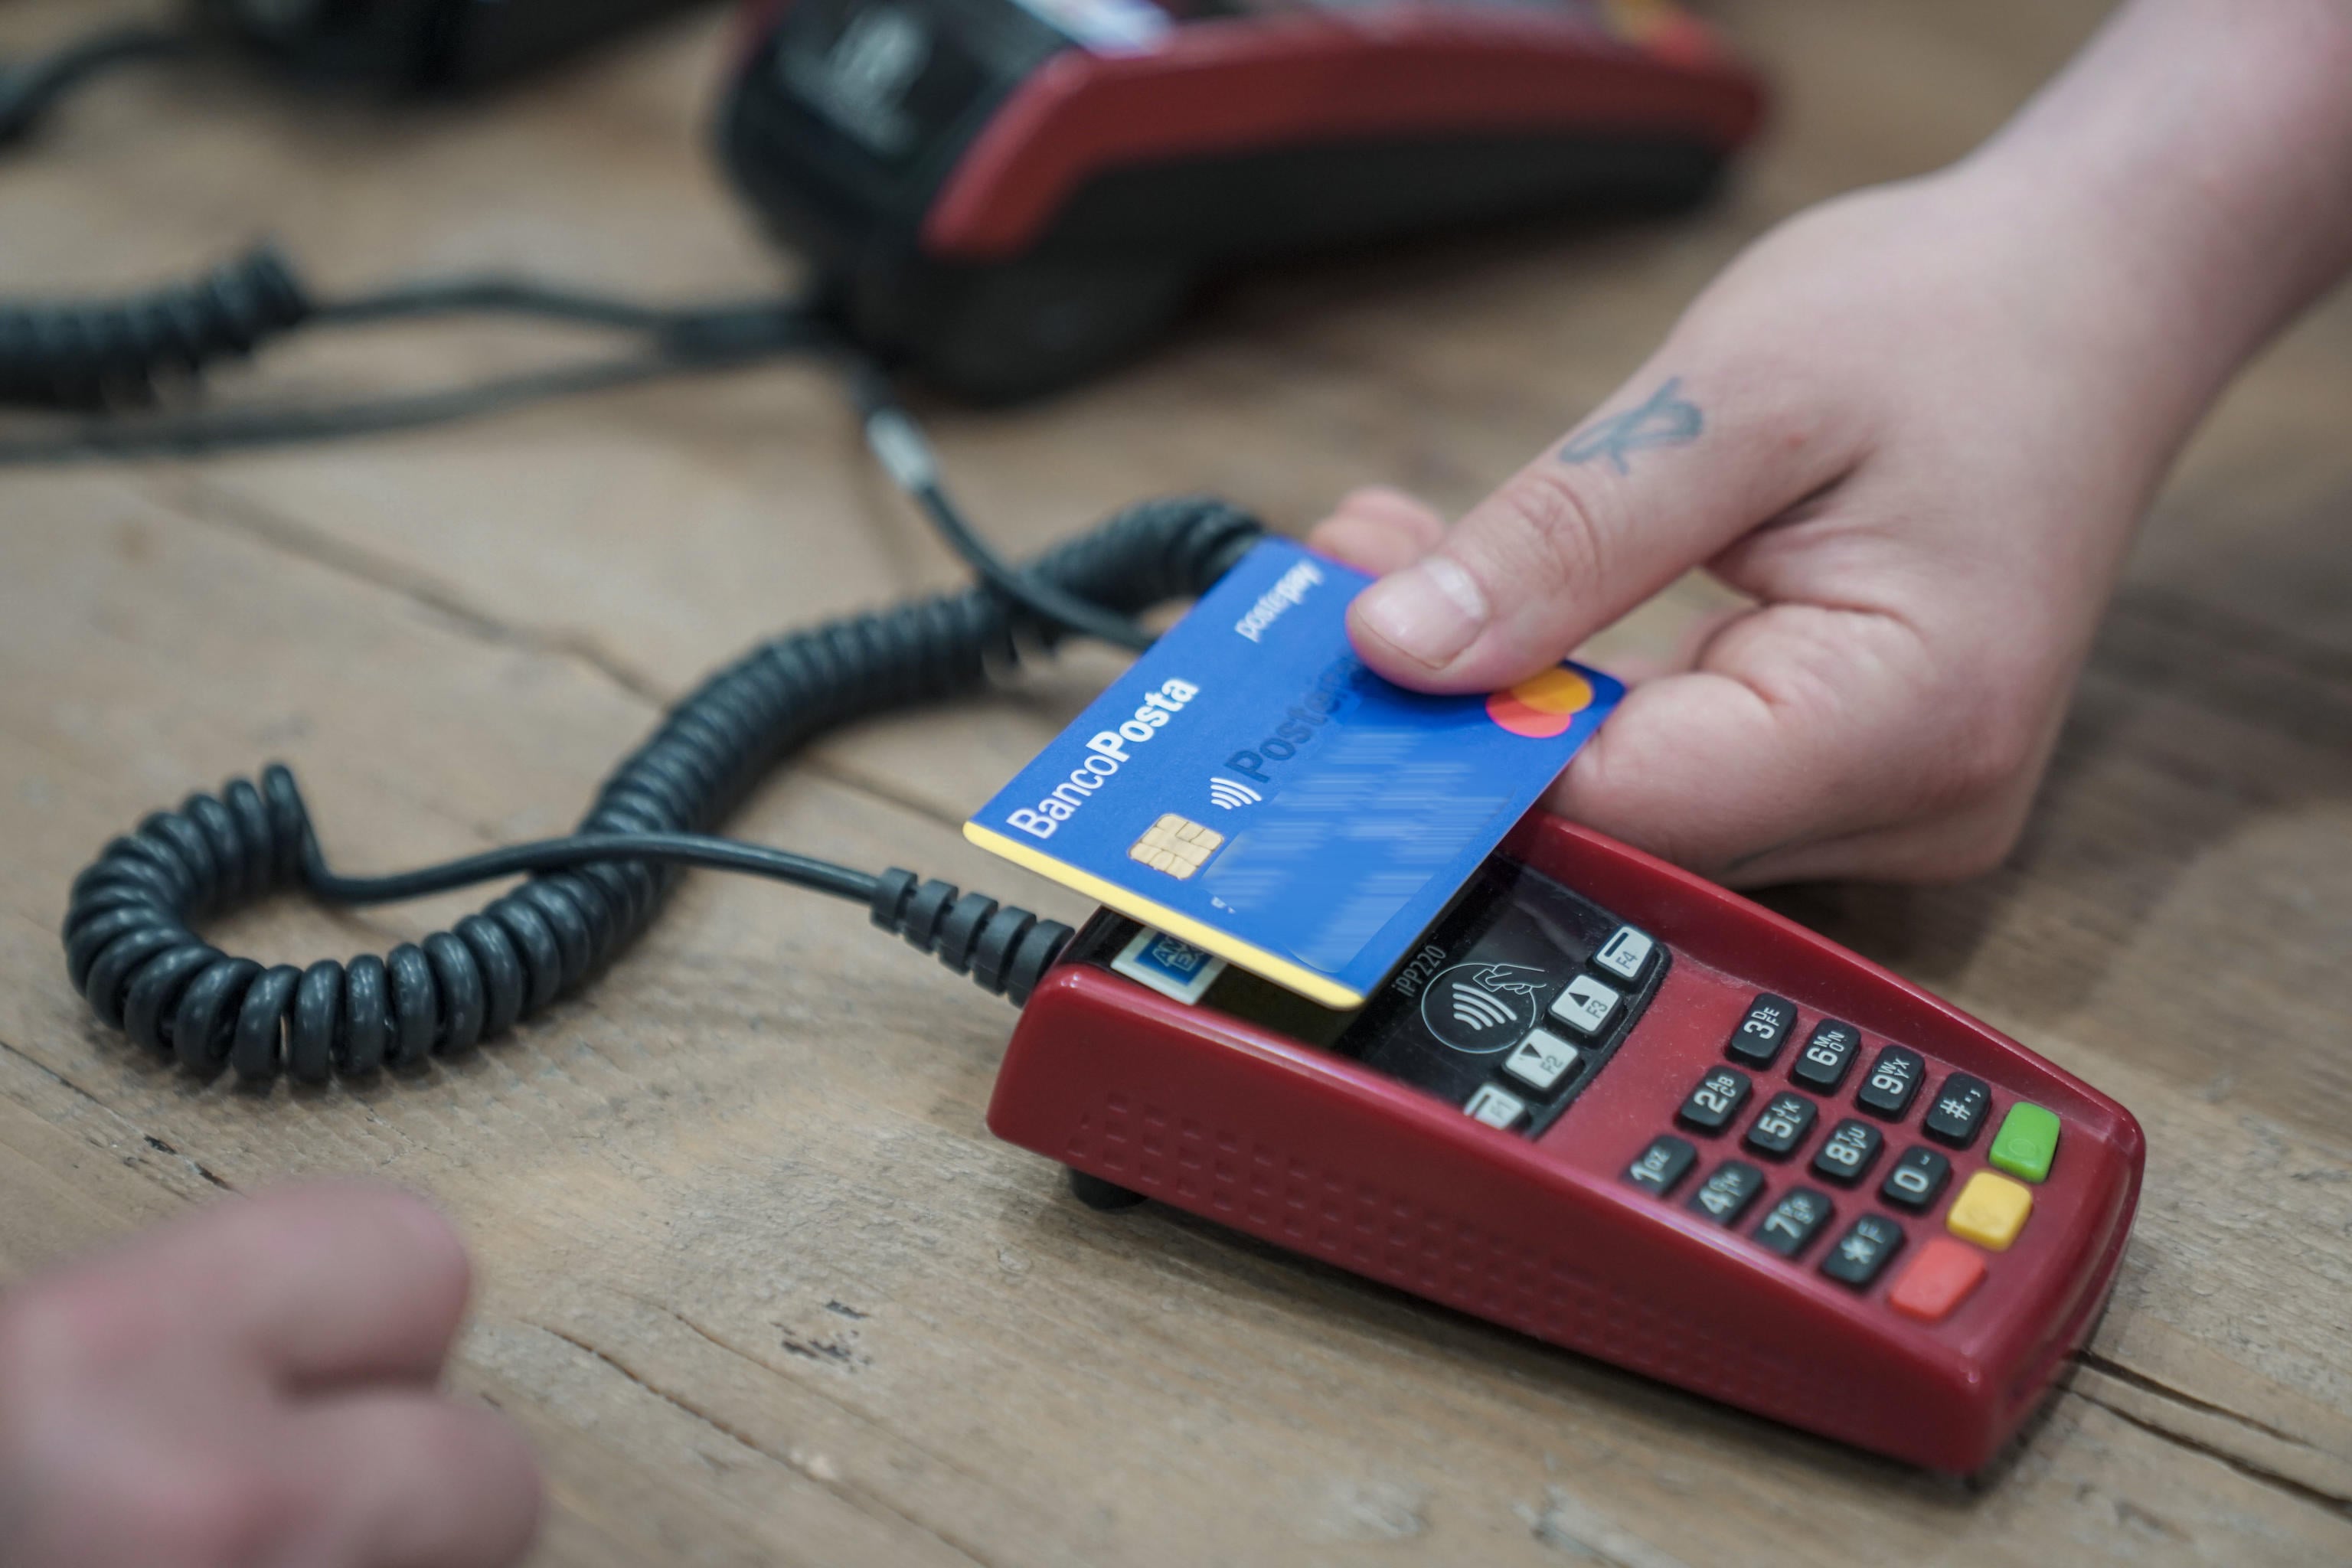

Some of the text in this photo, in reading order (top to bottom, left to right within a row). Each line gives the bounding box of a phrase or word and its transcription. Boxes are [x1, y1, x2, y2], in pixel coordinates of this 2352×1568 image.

[1234, 558, 1325, 643] postepay
[1005, 677, 1200, 839] BancoPosta
[1393, 945, 1446, 997] iPP220
[1615, 950, 1638, 970] F4
[1586, 1000, 1609, 1020] F3
[1540, 1054, 1563, 1074] F2
[1893, 1167, 1929, 1193] 0
